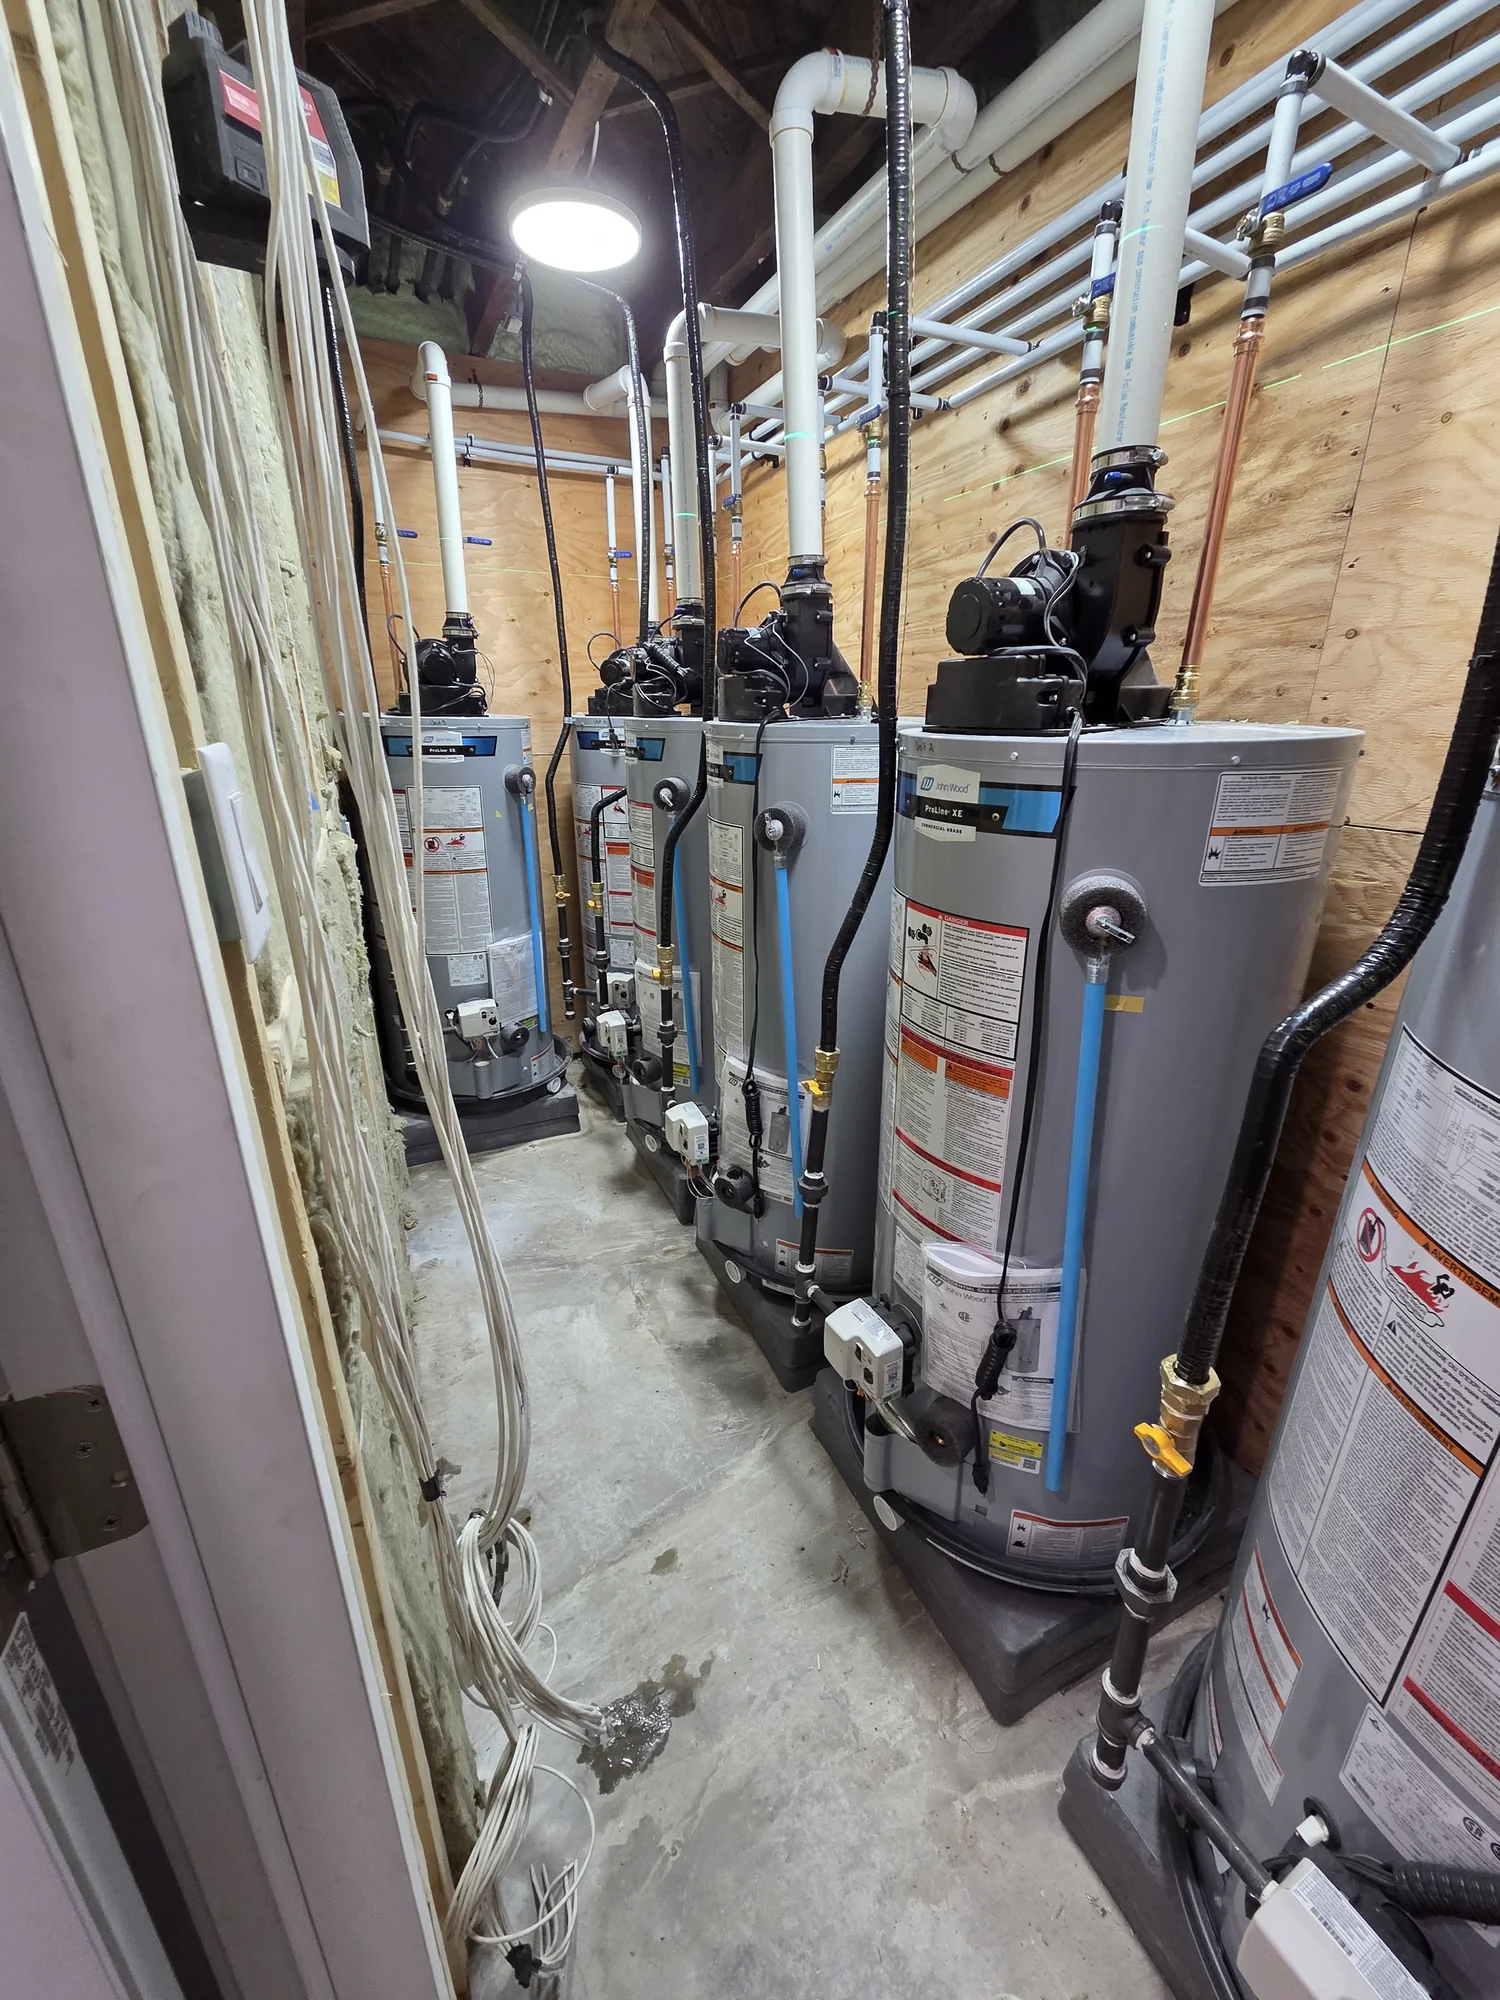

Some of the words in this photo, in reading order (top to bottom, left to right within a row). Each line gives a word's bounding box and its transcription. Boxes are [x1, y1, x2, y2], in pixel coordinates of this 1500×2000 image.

[1147, 126, 1158, 174] construction
[1136, 249, 1144, 266] sous
[1130, 269, 1142, 314] construction
[1121, 379, 1131, 401] Follow
[935, 782, 949, 791] John
[950, 783, 969, 793] Wood
[924, 804, 950, 815] ProLine
[951, 808, 963, 818] XE
[944, 914, 969, 926] DANGER
